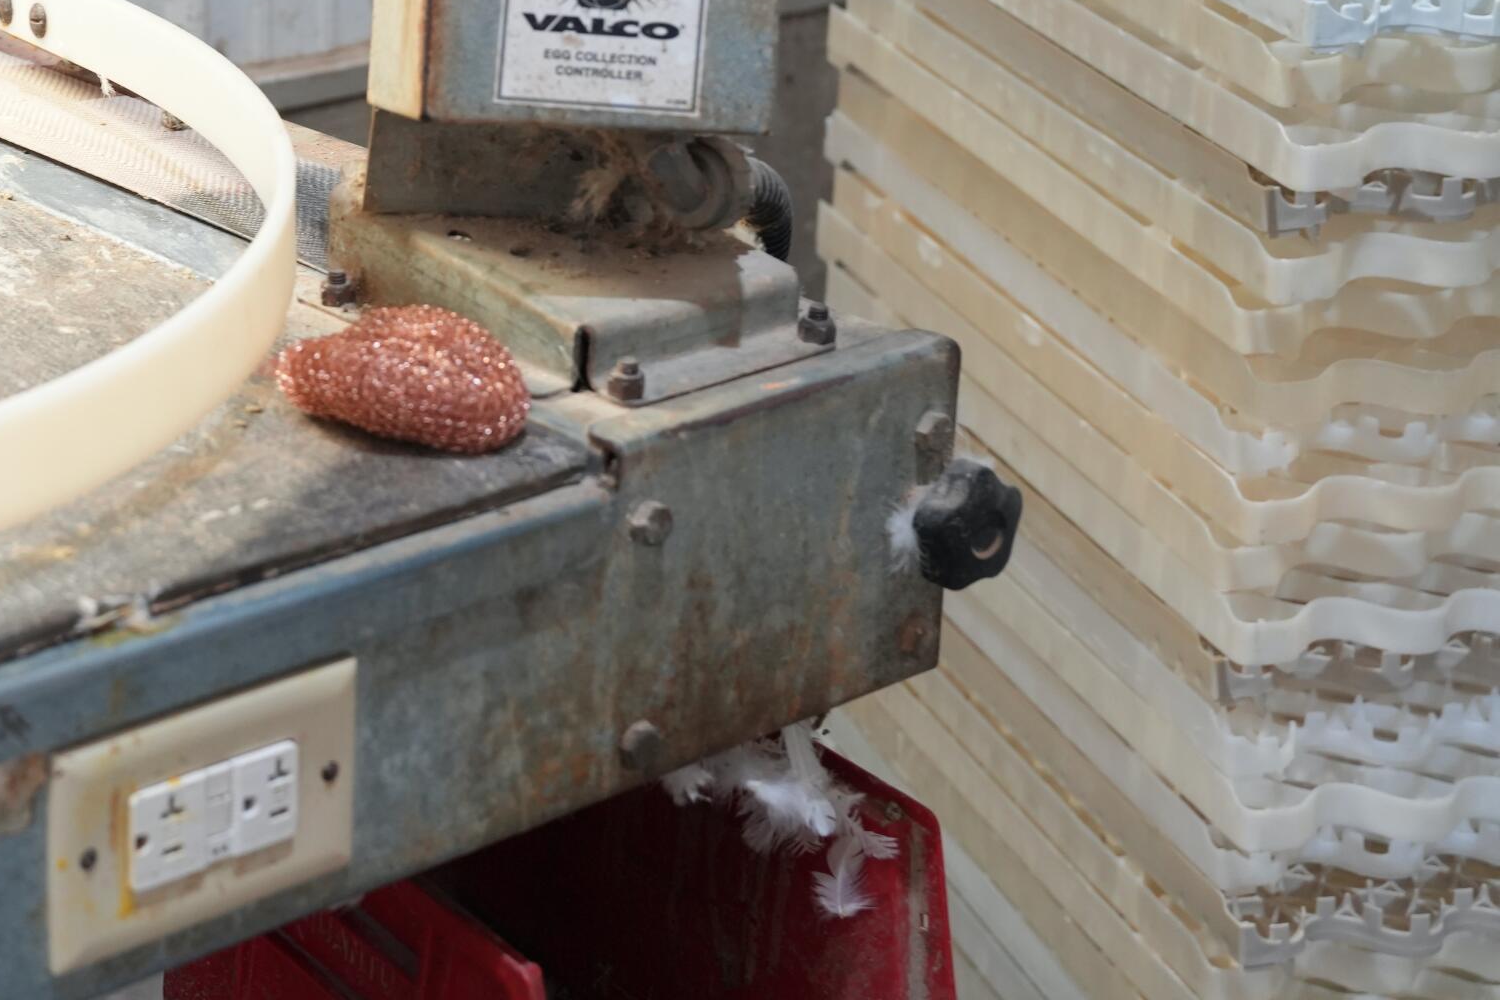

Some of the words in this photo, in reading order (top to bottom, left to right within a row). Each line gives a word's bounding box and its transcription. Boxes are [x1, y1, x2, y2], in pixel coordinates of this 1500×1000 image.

[523, 12, 680, 40] VALCO
[544, 49, 572, 61] EGG
[575, 51, 657, 66] COLLECTION
[556, 65, 643, 80] CONTROLLER
